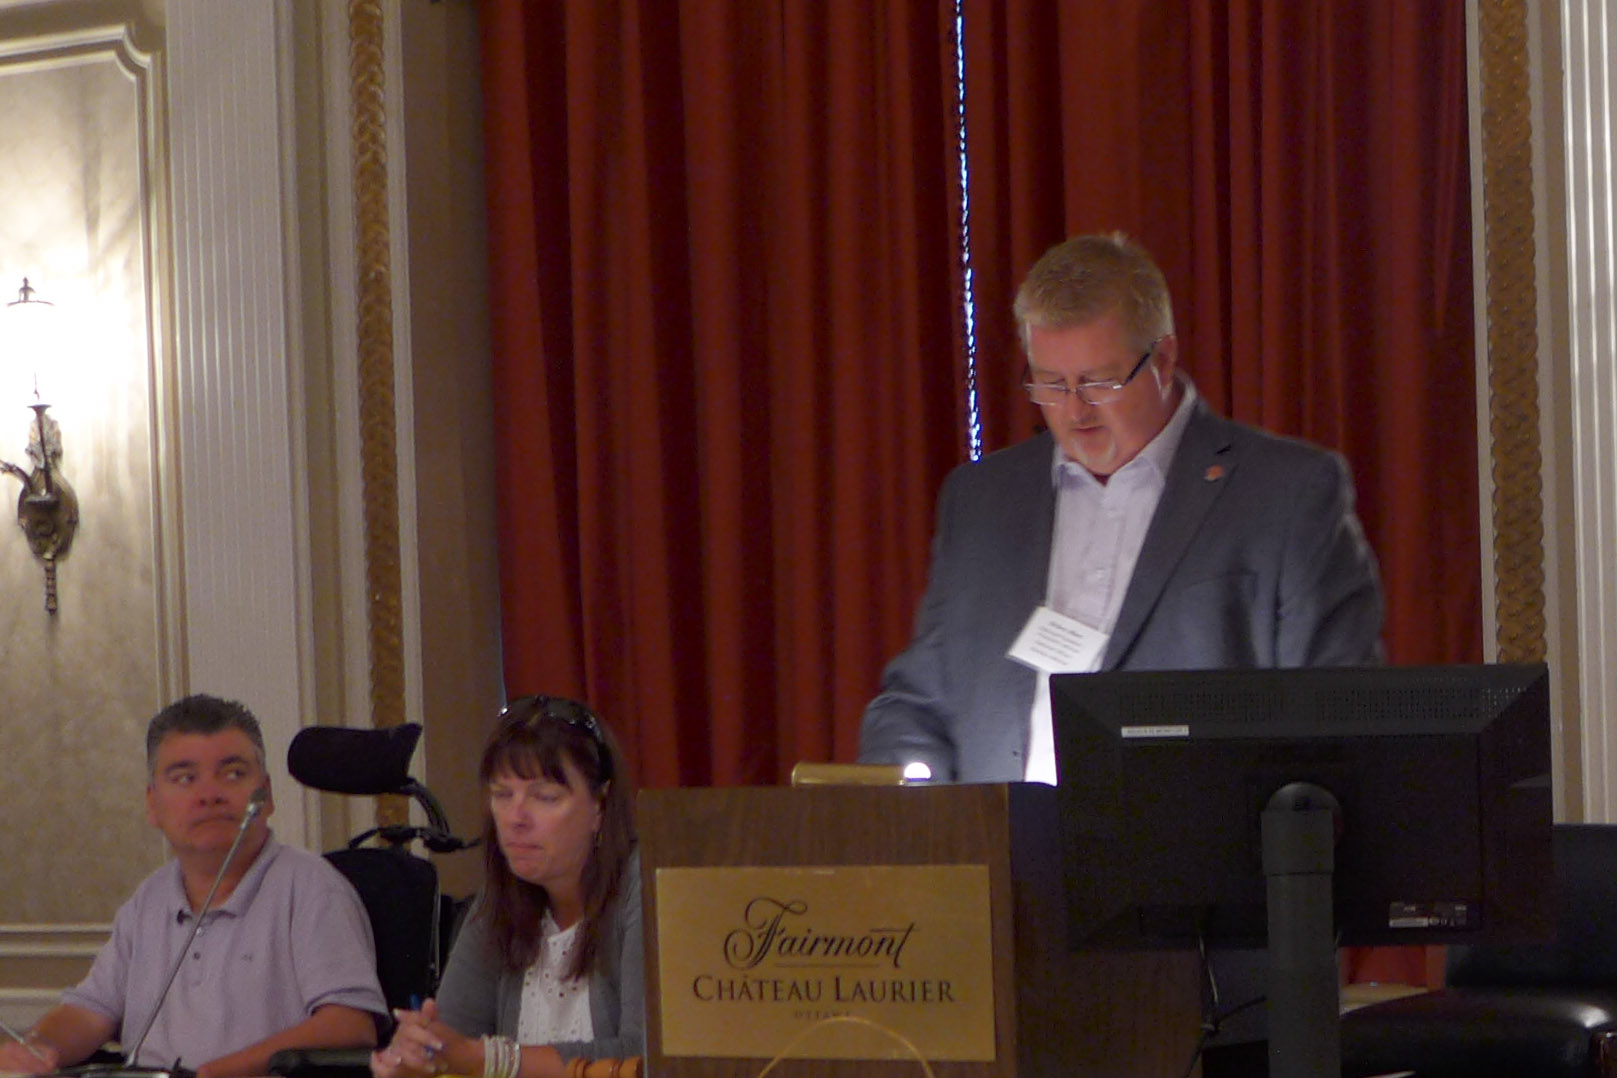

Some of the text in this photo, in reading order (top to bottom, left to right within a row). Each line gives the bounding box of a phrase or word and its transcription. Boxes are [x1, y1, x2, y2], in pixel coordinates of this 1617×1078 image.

[723, 897, 919, 970] Fairmont
[692, 974, 955, 1002] CHÂTEAU LAURIER
